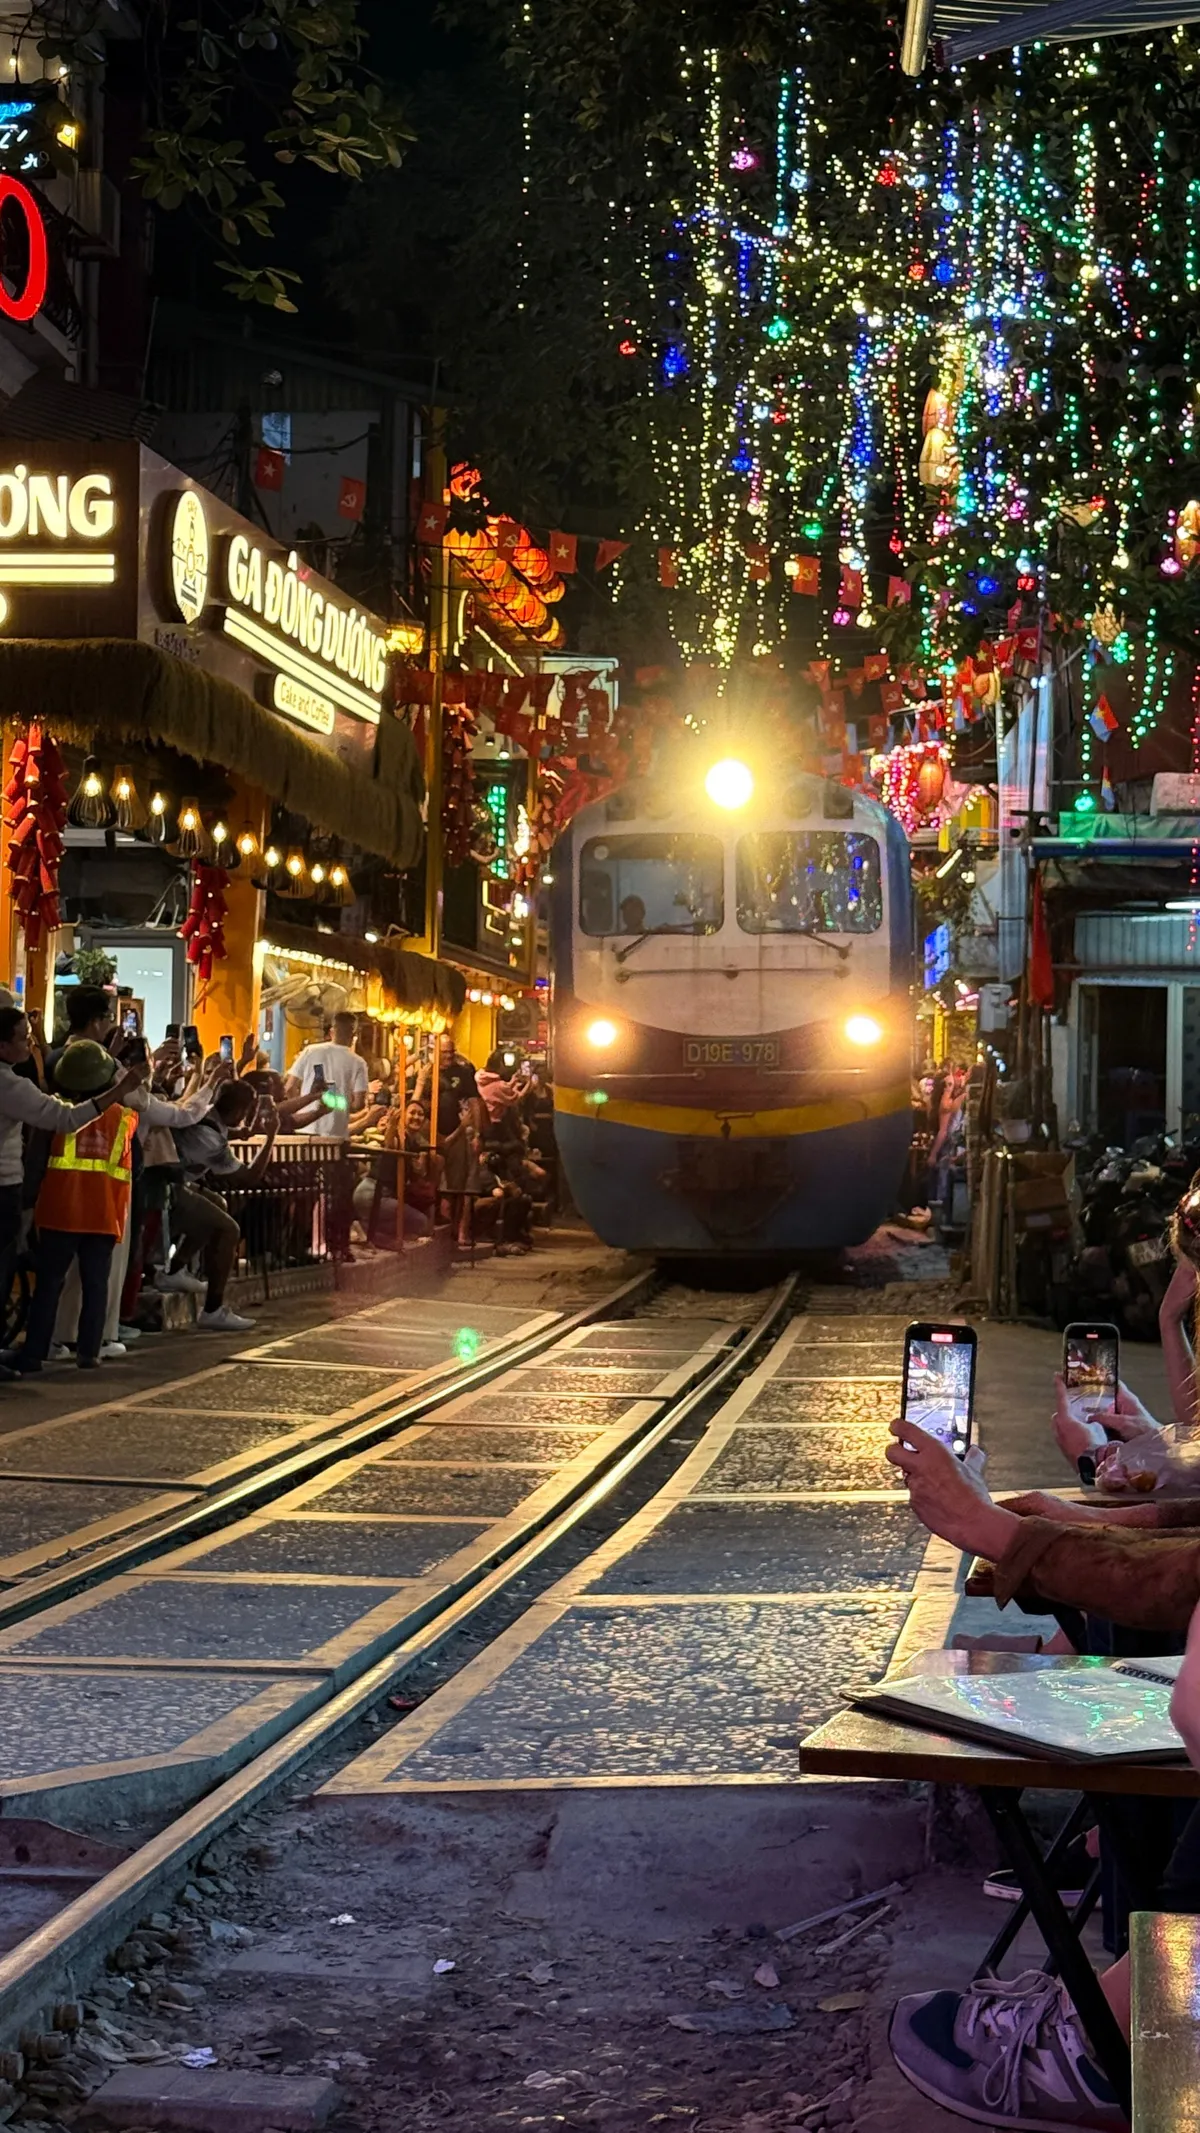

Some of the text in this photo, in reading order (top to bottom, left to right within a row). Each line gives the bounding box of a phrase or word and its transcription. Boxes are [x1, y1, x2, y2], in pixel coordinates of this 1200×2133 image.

[228, 535, 386, 693] GA ĐÔNG DƯƠNG
[281, 681, 330, 727] Cake and Coffee
